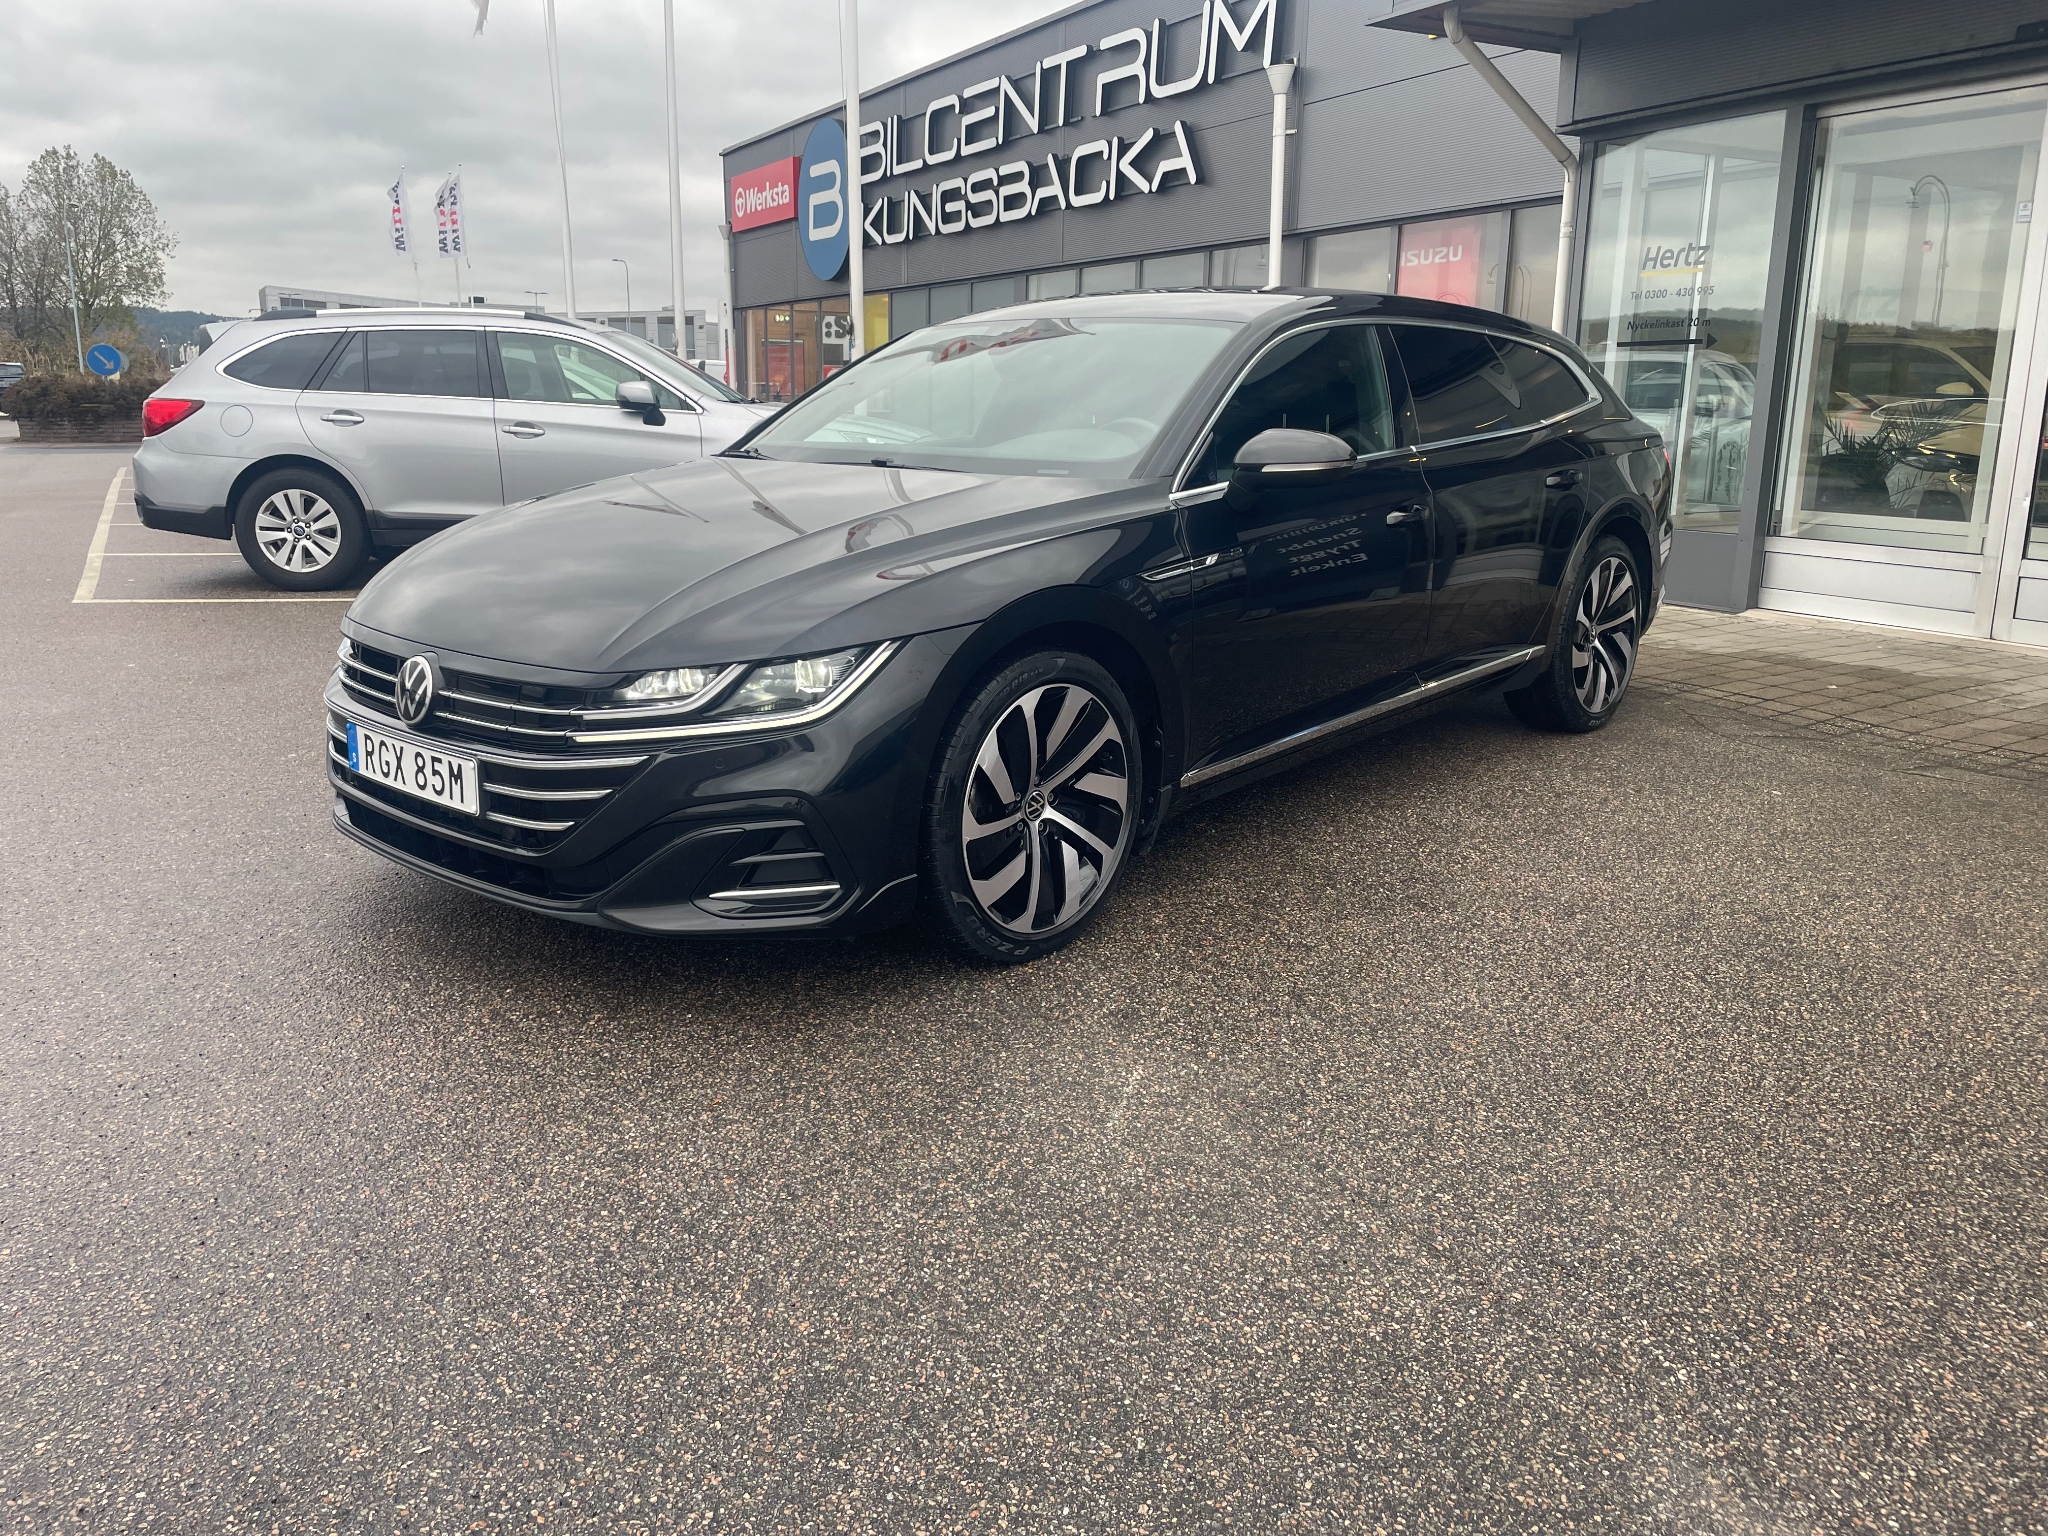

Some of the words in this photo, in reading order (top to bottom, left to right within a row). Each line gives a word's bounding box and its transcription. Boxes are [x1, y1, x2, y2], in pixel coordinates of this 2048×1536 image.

[859, 0, 1278, 185] BILCENTRUM
[745, 181, 790, 214] Werksta
[861, 119, 1197, 246] KUNGSBACKA
[1400, 244, 1463, 267] ISUZU
[1641, 242, 1711, 271] Hertz
[1630, 291, 1643, 301] Tel
[1644, 289, 1668, 300] 0300
[1675, 287, 1694, 298] 430
[1696, 285, 1715, 296] 995
[1627, 318, 1686, 332] Nyckelinkast
[1687, 317, 1700, 328] 20
[1701, 319, 1711, 327] m
[363, 733, 407, 786] RGX
[414, 750, 465, 805] 85M
